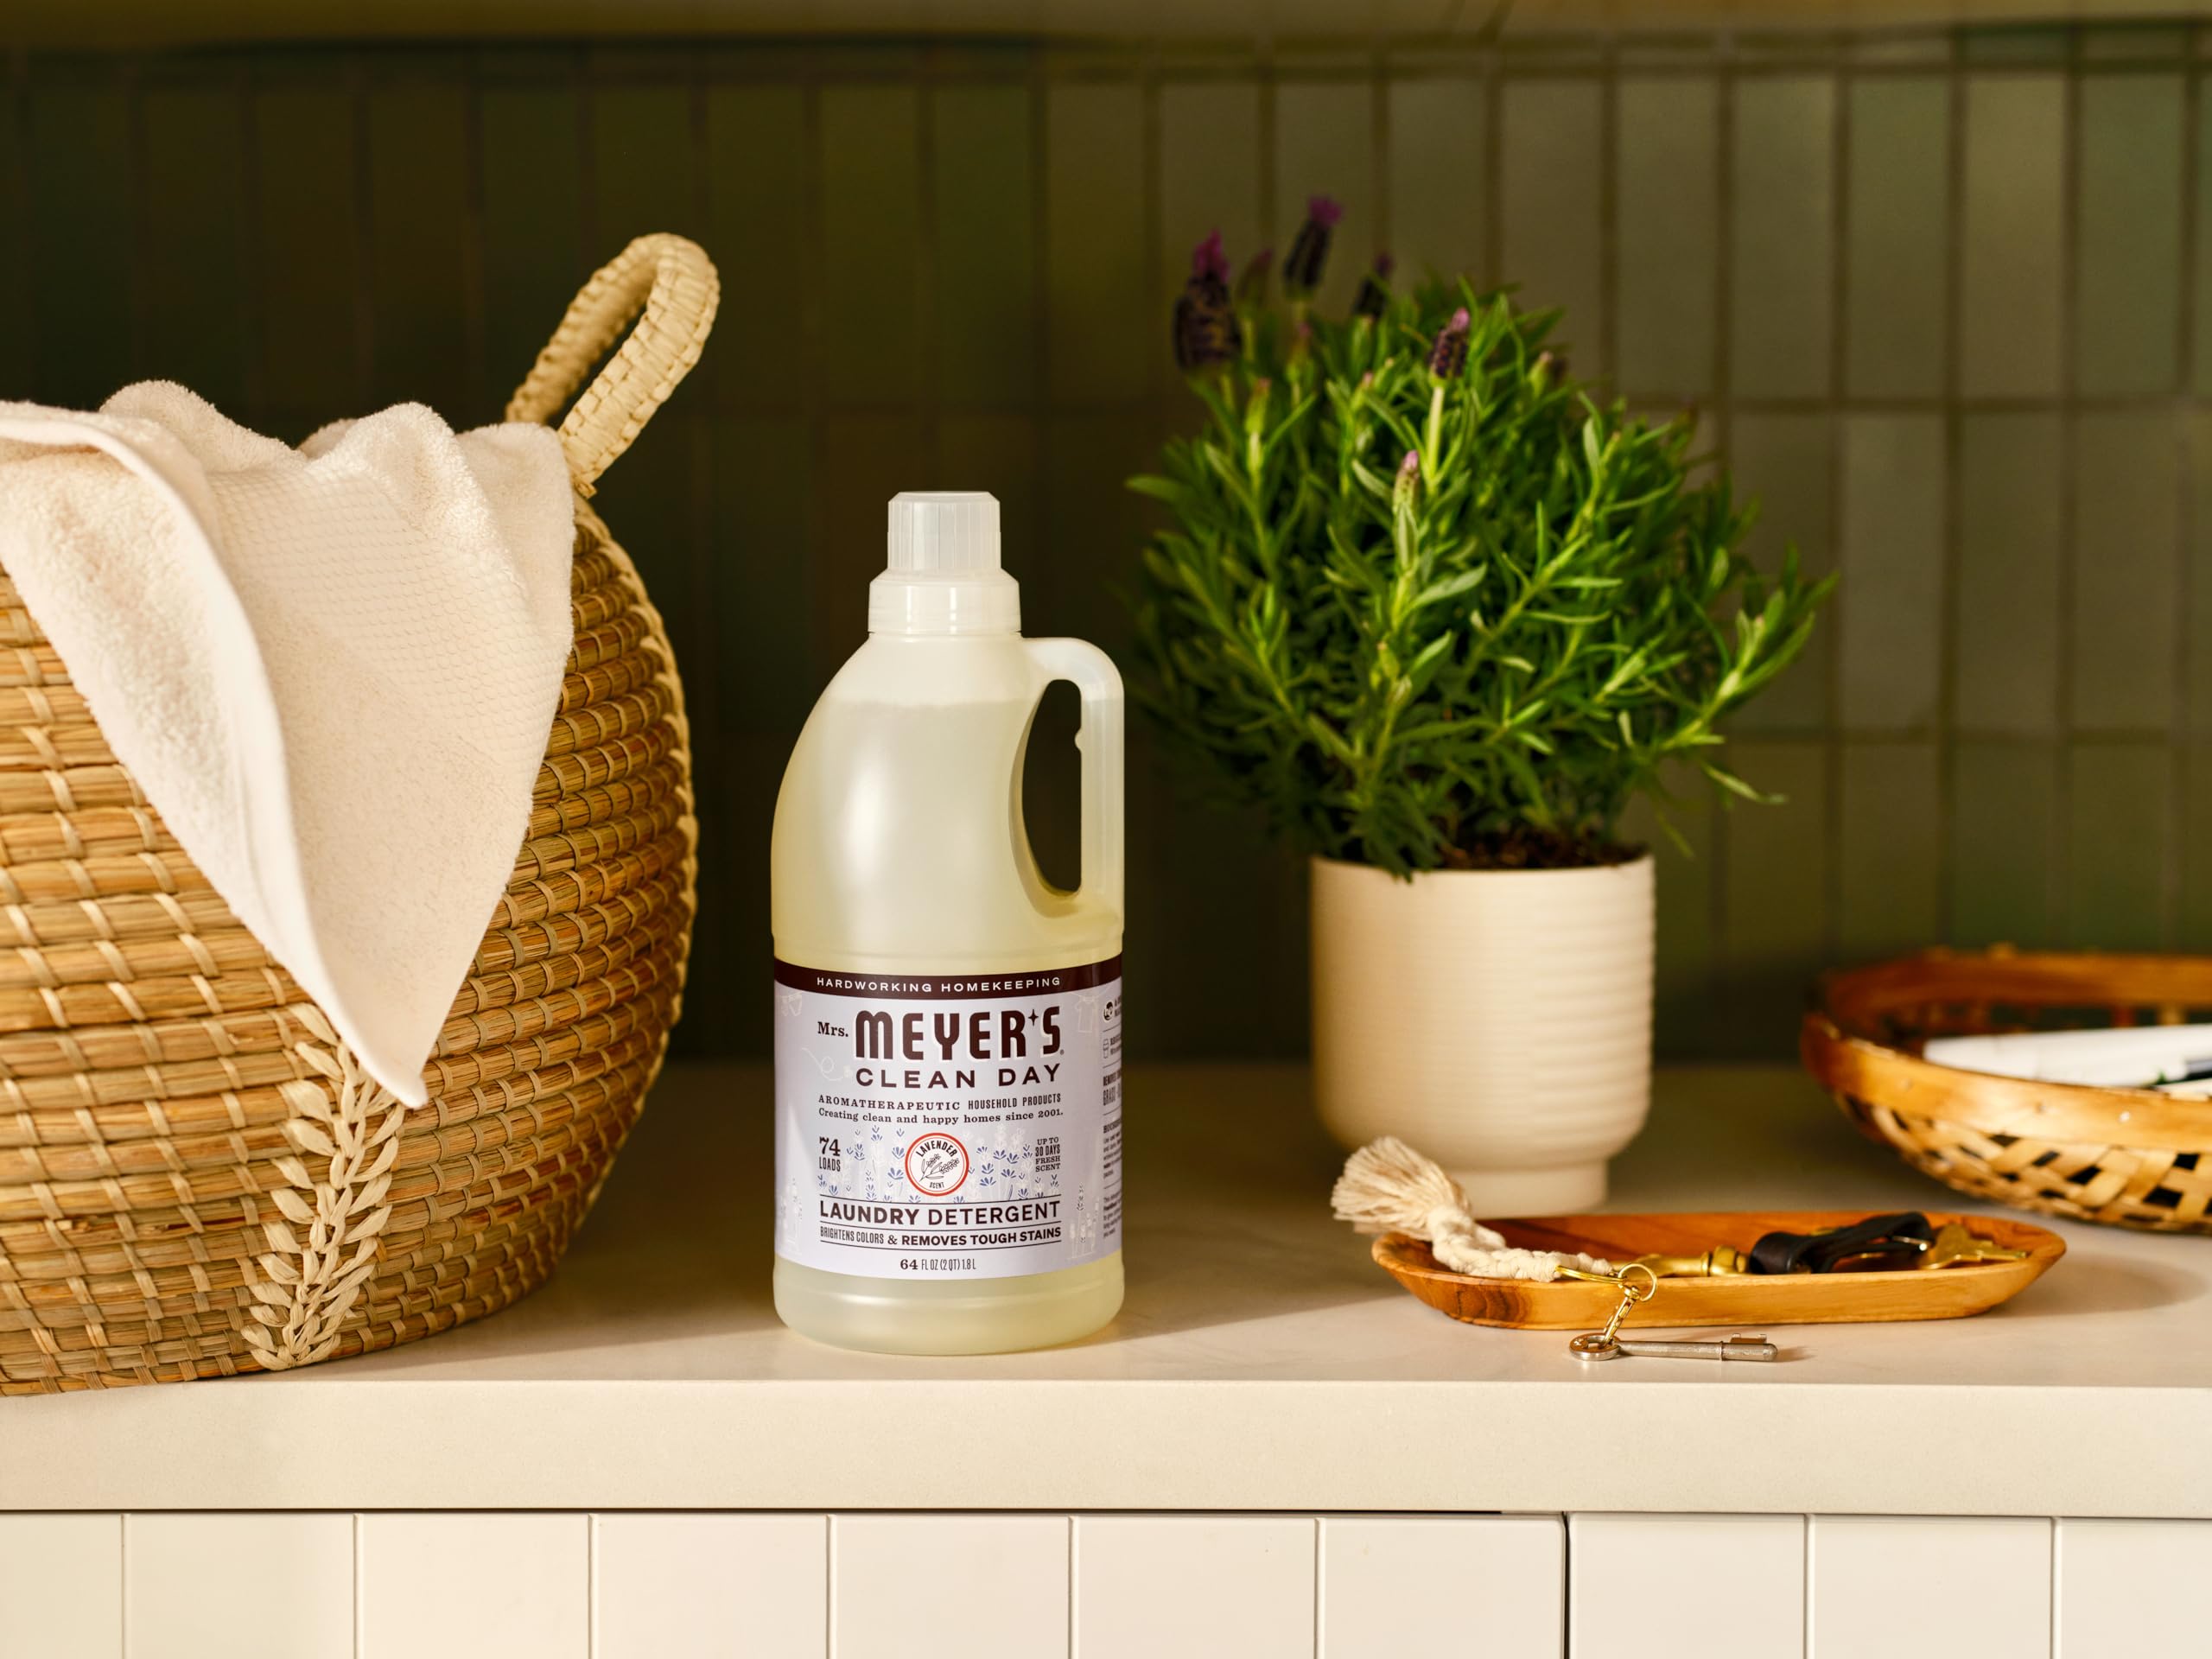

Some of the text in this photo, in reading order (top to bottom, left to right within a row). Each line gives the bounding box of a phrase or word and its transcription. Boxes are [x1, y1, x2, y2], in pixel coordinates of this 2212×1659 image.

[817, 976, 1061, 993] HARDWORKING HOMEKEEPING
[817, 1021, 849, 1038] Mrs.
[855, 1063, 1061, 1089] CLEAN DAY
[817, 1092, 1061, 1111] AROMATHERAPEUTIC HOUSEHOLD PRODUCTS
[817, 1107, 1064, 1125] Creating clean and happy homes since 2001.
[819, 1136, 841, 1156] 74
[916, 1140, 957, 1157] LAVENDER
[1035, 1143, 1060, 1157] 30 DAYS
[819, 1156, 841, 1172] LOADS
[1035, 1155, 1061, 1165] FRESH
[1035, 1162, 1061, 1173] SCENT
[820, 1199, 1061, 1225] LAUNDRY DETERGENT
[820, 1226, 1062, 1246] BRIGHTENS COLORS & REMOVES TOUGH STAINS
[899, 1258, 918, 1270] 64
[921, 1258, 928, 1270] FL
[930, 1258, 938, 1270] OZ
[962, 1258, 971, 1270] 1.8
[973, 1258, 976, 1270] L
